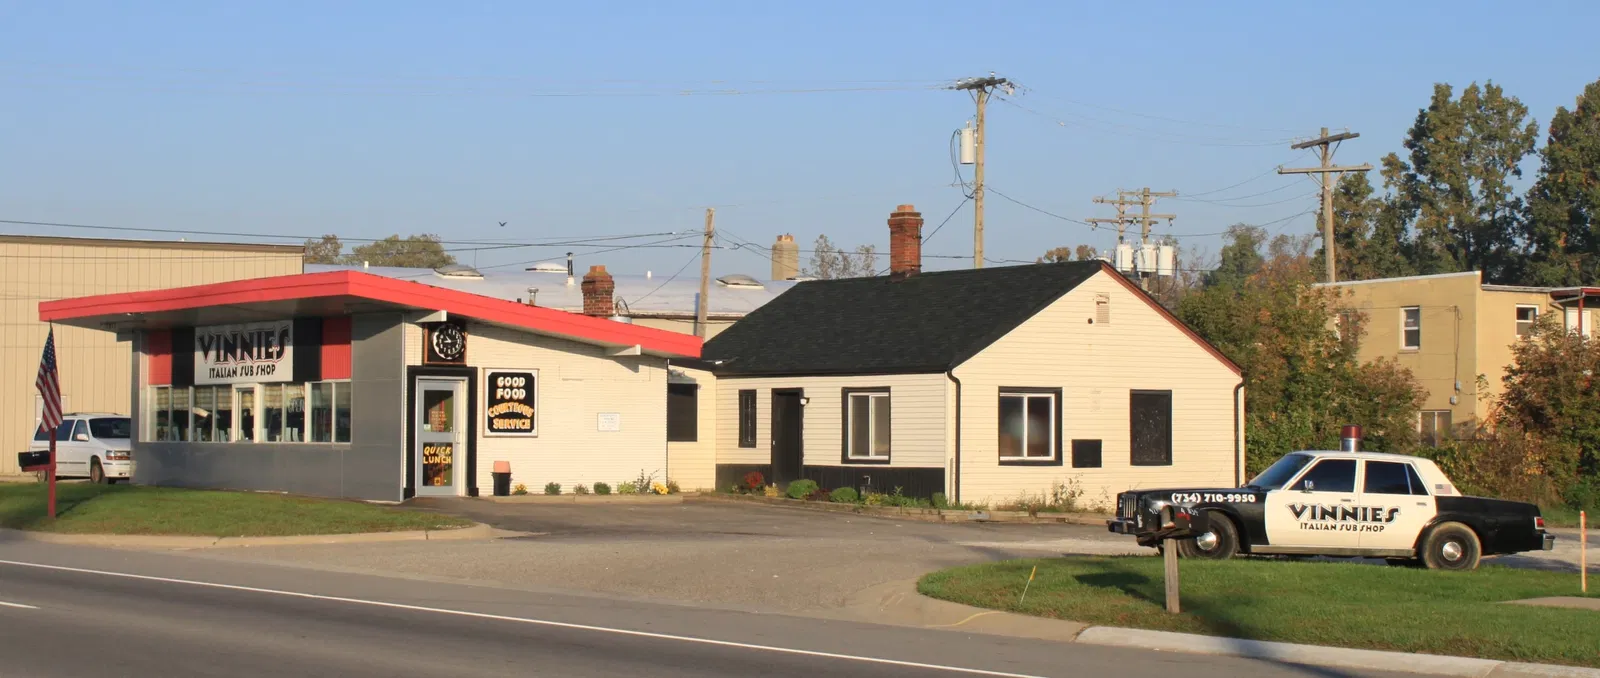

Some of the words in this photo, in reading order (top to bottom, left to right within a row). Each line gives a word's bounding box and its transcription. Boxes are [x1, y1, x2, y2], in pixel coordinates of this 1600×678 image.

[198, 326, 290, 363] VINNIES
[209, 367, 238, 379] ITALIAN
[240, 365, 254, 377] SUB
[256, 364, 276, 376] SHOP
[497, 376, 526, 388] GOOD
[496, 388, 526, 400] FOOD
[488, 401, 535, 418] COURTEOUS
[493, 418, 531, 429] SERVICE
[424, 446, 452, 456] QUICK
[423, 456, 452, 464] LUNCH
[1171, 492, 1202, 503] (734)
[1204, 493, 1256, 503] 710-9950
[1287, 503, 1400, 524] VINNIES
[1300, 522, 1337, 531] ITALIAN
[1340, 523, 1358, 532] SUB
[1360, 524, 1385, 533] SHOP
